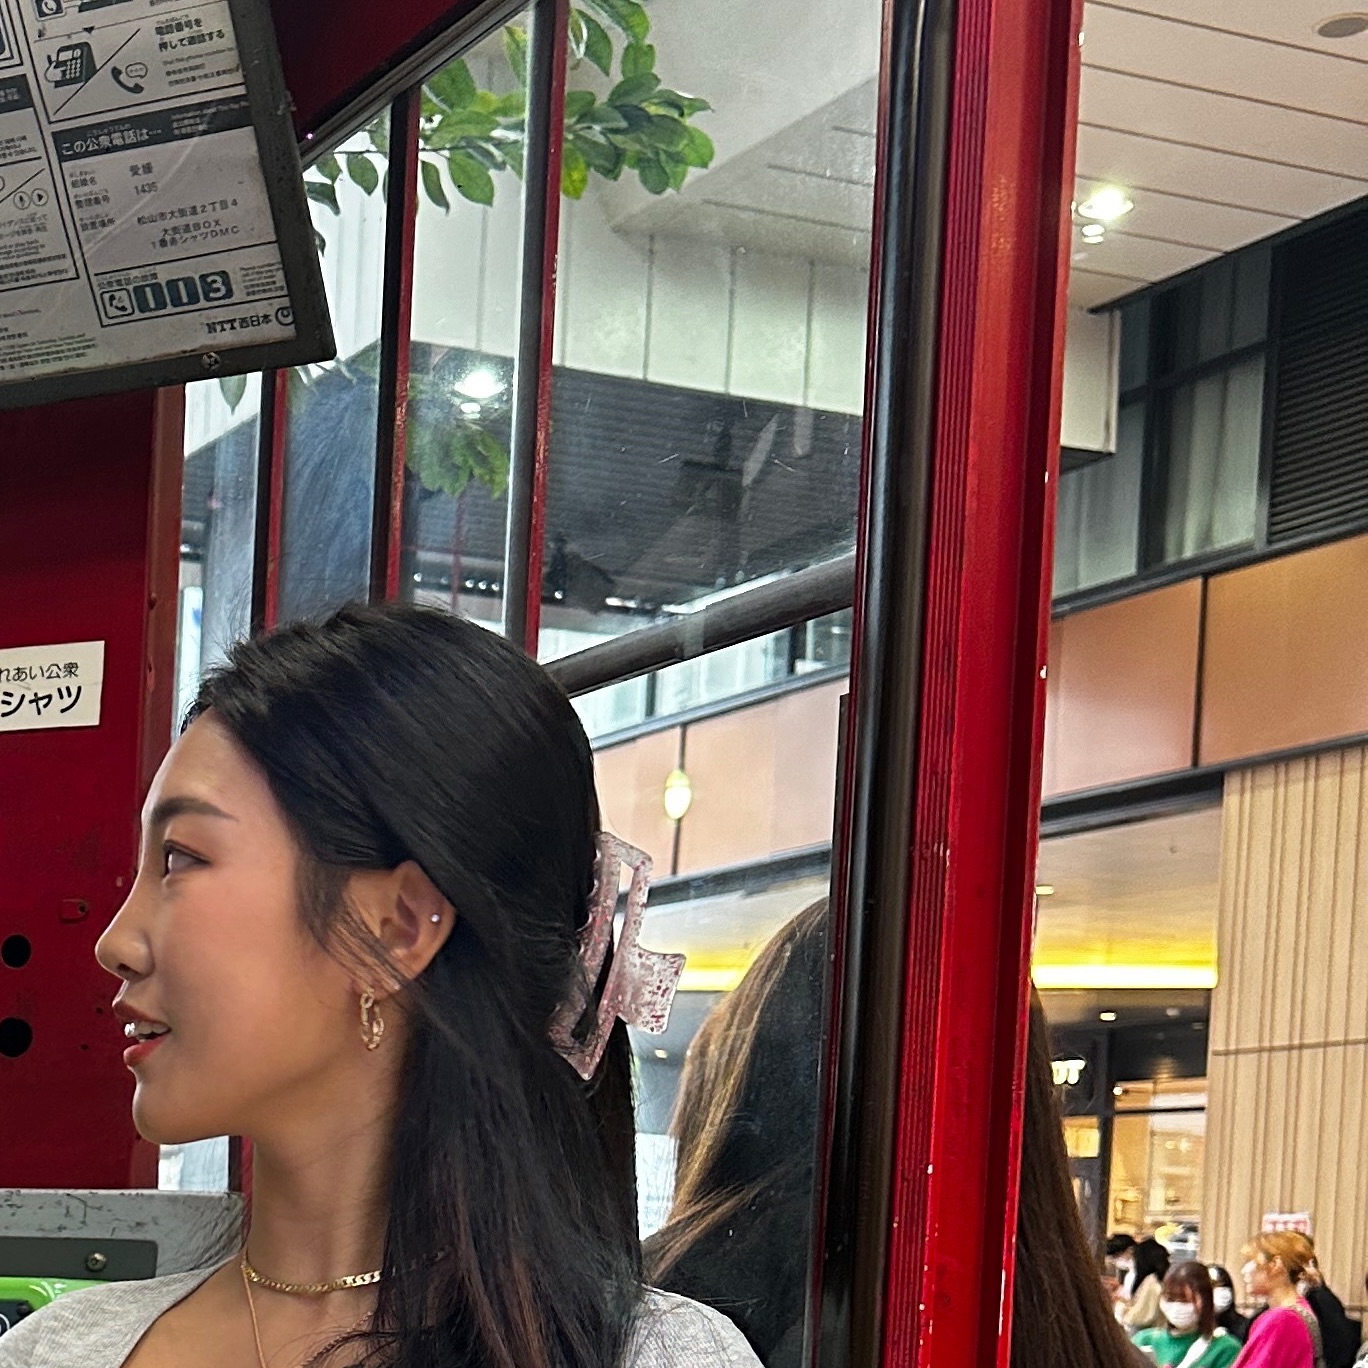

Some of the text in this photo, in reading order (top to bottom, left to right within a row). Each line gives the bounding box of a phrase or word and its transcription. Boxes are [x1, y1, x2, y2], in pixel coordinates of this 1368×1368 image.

[142, 274, 227, 312] 113
[206, 313, 273, 335] NTT西日本
